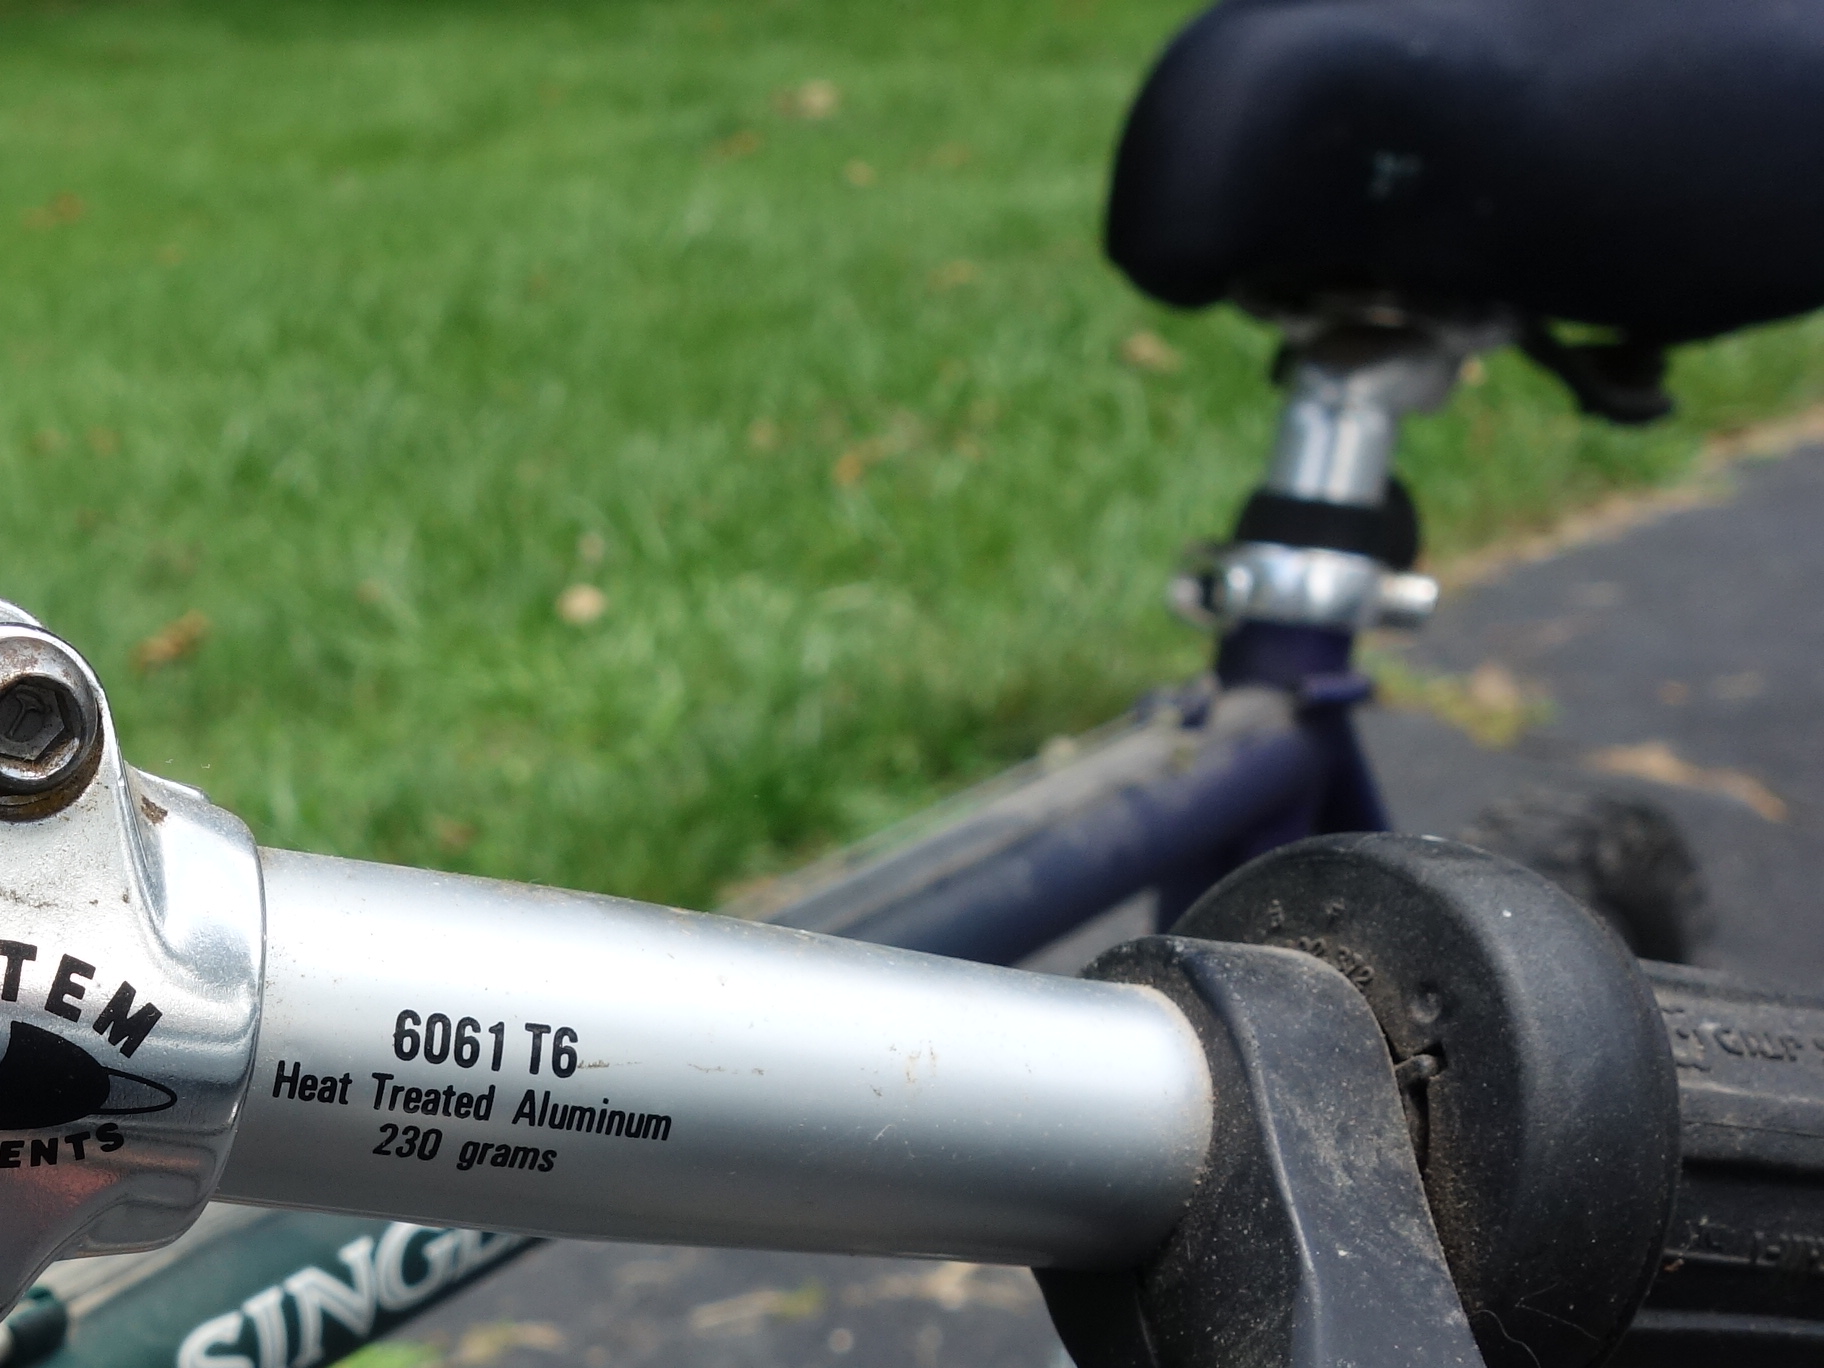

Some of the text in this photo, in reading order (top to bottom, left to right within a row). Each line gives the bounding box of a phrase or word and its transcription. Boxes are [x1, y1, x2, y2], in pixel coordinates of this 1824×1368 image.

[393, 1008, 579, 1079] 6061 T6
[272, 1060, 672, 1141] Heat Treated Aluminum
[372, 1123, 558, 1172] 230 grams
